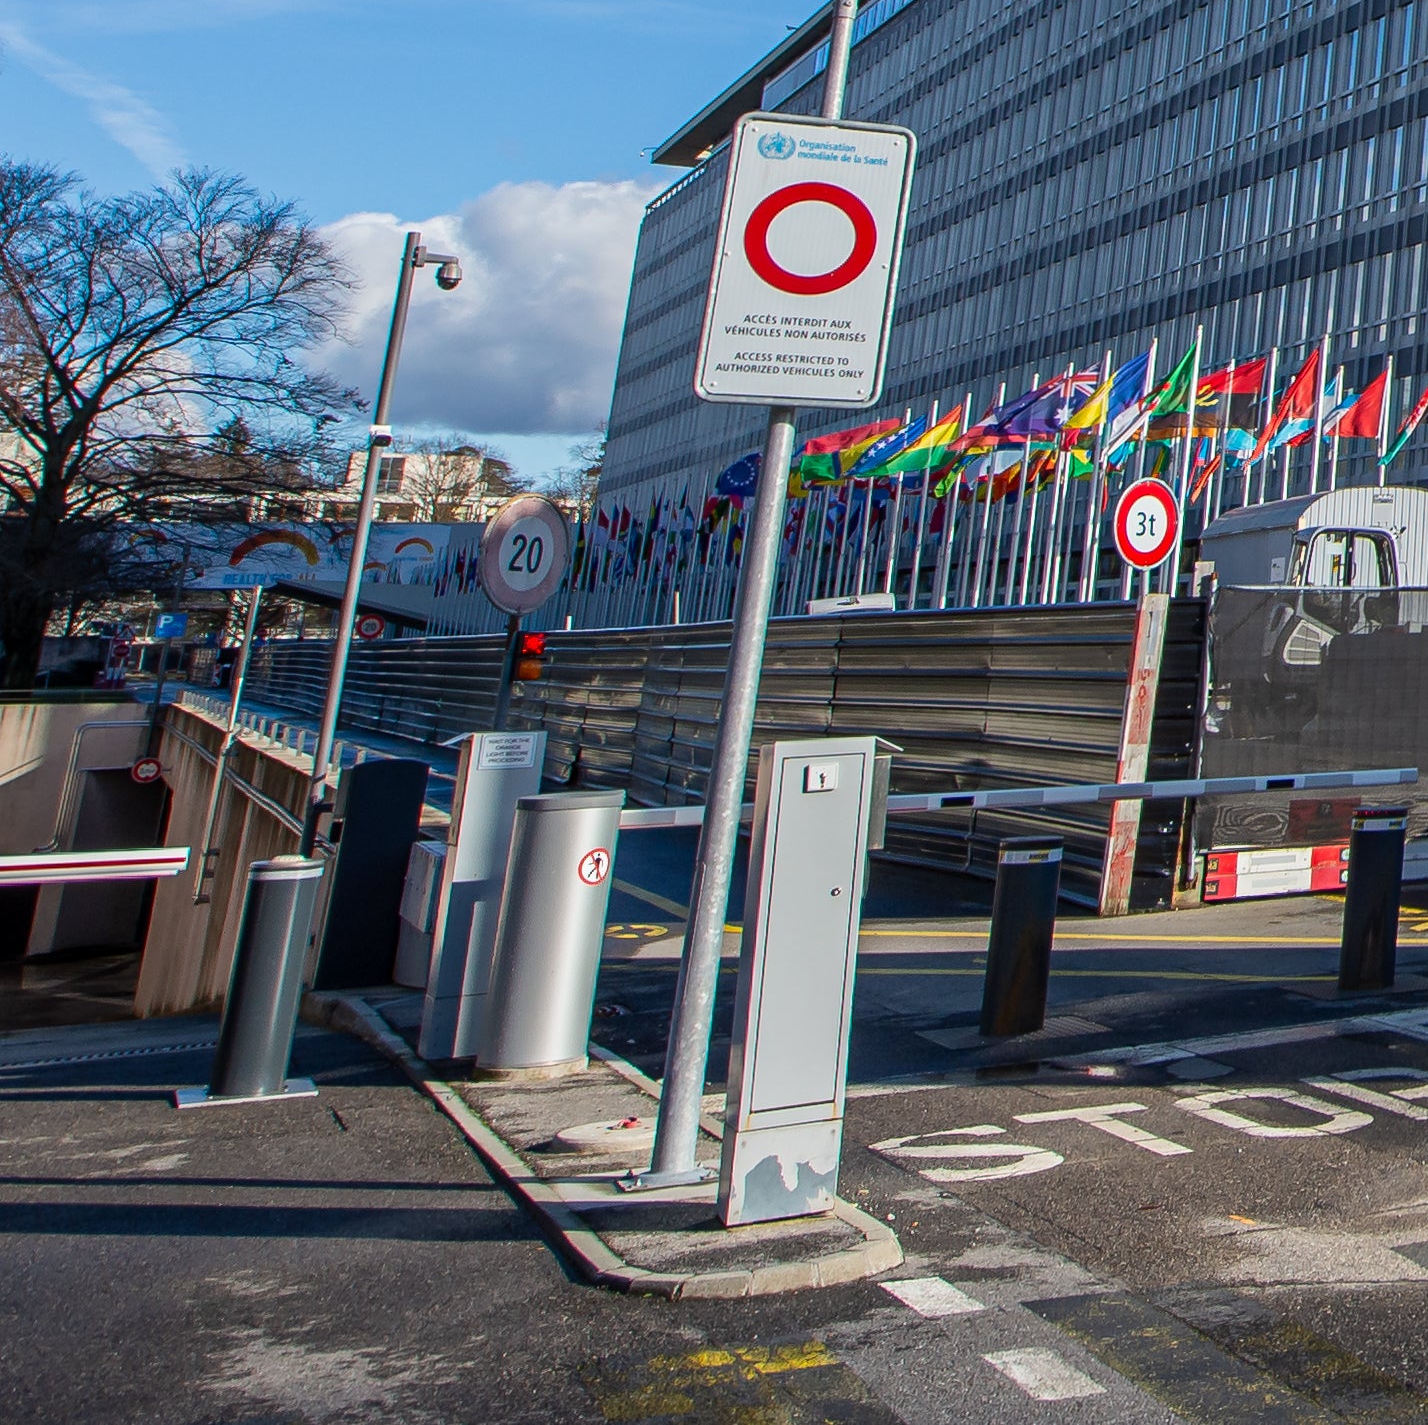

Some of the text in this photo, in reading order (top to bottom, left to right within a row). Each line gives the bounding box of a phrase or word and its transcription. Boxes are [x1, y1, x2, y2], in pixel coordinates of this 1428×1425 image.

[799, 139, 856, 152] Organisation
[797, 150, 888, 167] mondiale de la Santé
[743, 314, 852, 329] ACCÈS INTERDIT AUX
[725, 325, 867, 343] VÉHICULES NON AUTORISÉS
[734, 352, 849, 366] ACCESS RESTRICTED TO
[715, 363, 865, 379] AUTHORIZED VEHICULES ONLY
[1135, 511, 1156, 537] 3t
[508, 533, 544, 574] 20
[160, 614, 174, 629] P
